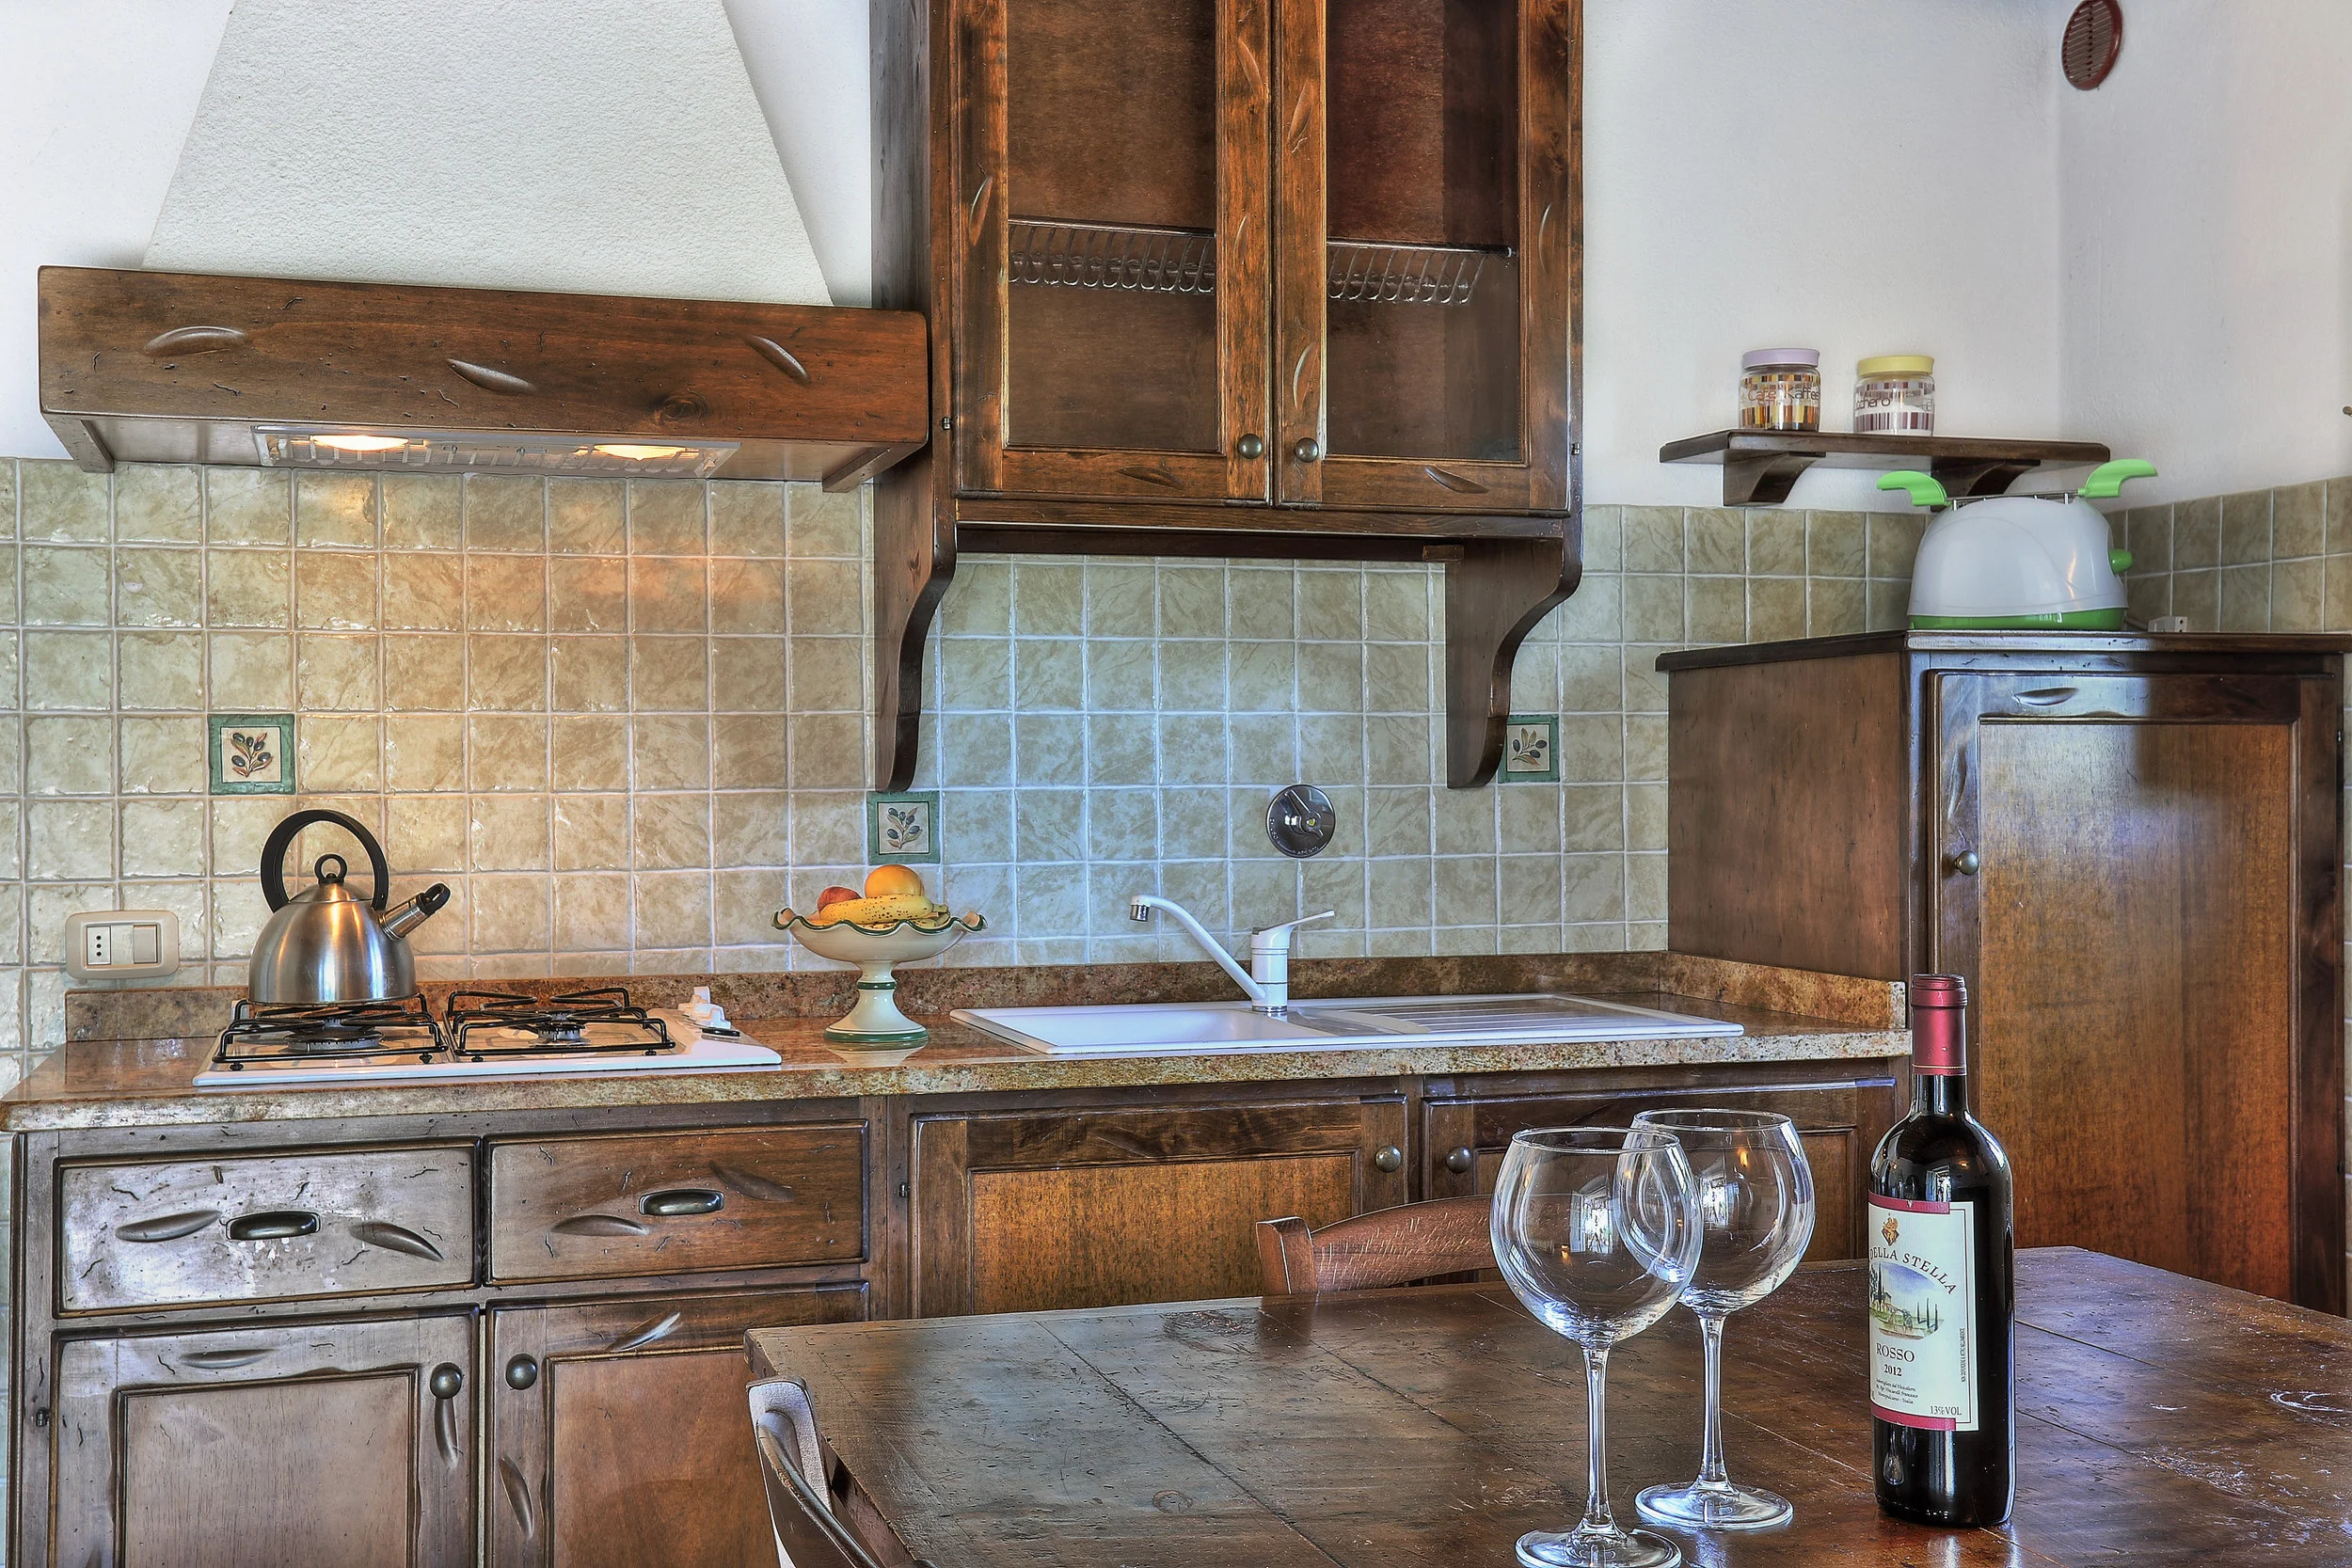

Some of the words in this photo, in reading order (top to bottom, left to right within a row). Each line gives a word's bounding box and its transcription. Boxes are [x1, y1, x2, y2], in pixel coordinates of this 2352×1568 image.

[1870, 1246, 1898, 1260] DELLA
[1902, 1252, 1957, 1294] STELLA
[1876, 1342, 1915, 1362] ROSSO
[1884, 1364, 1901, 1376] 2012
